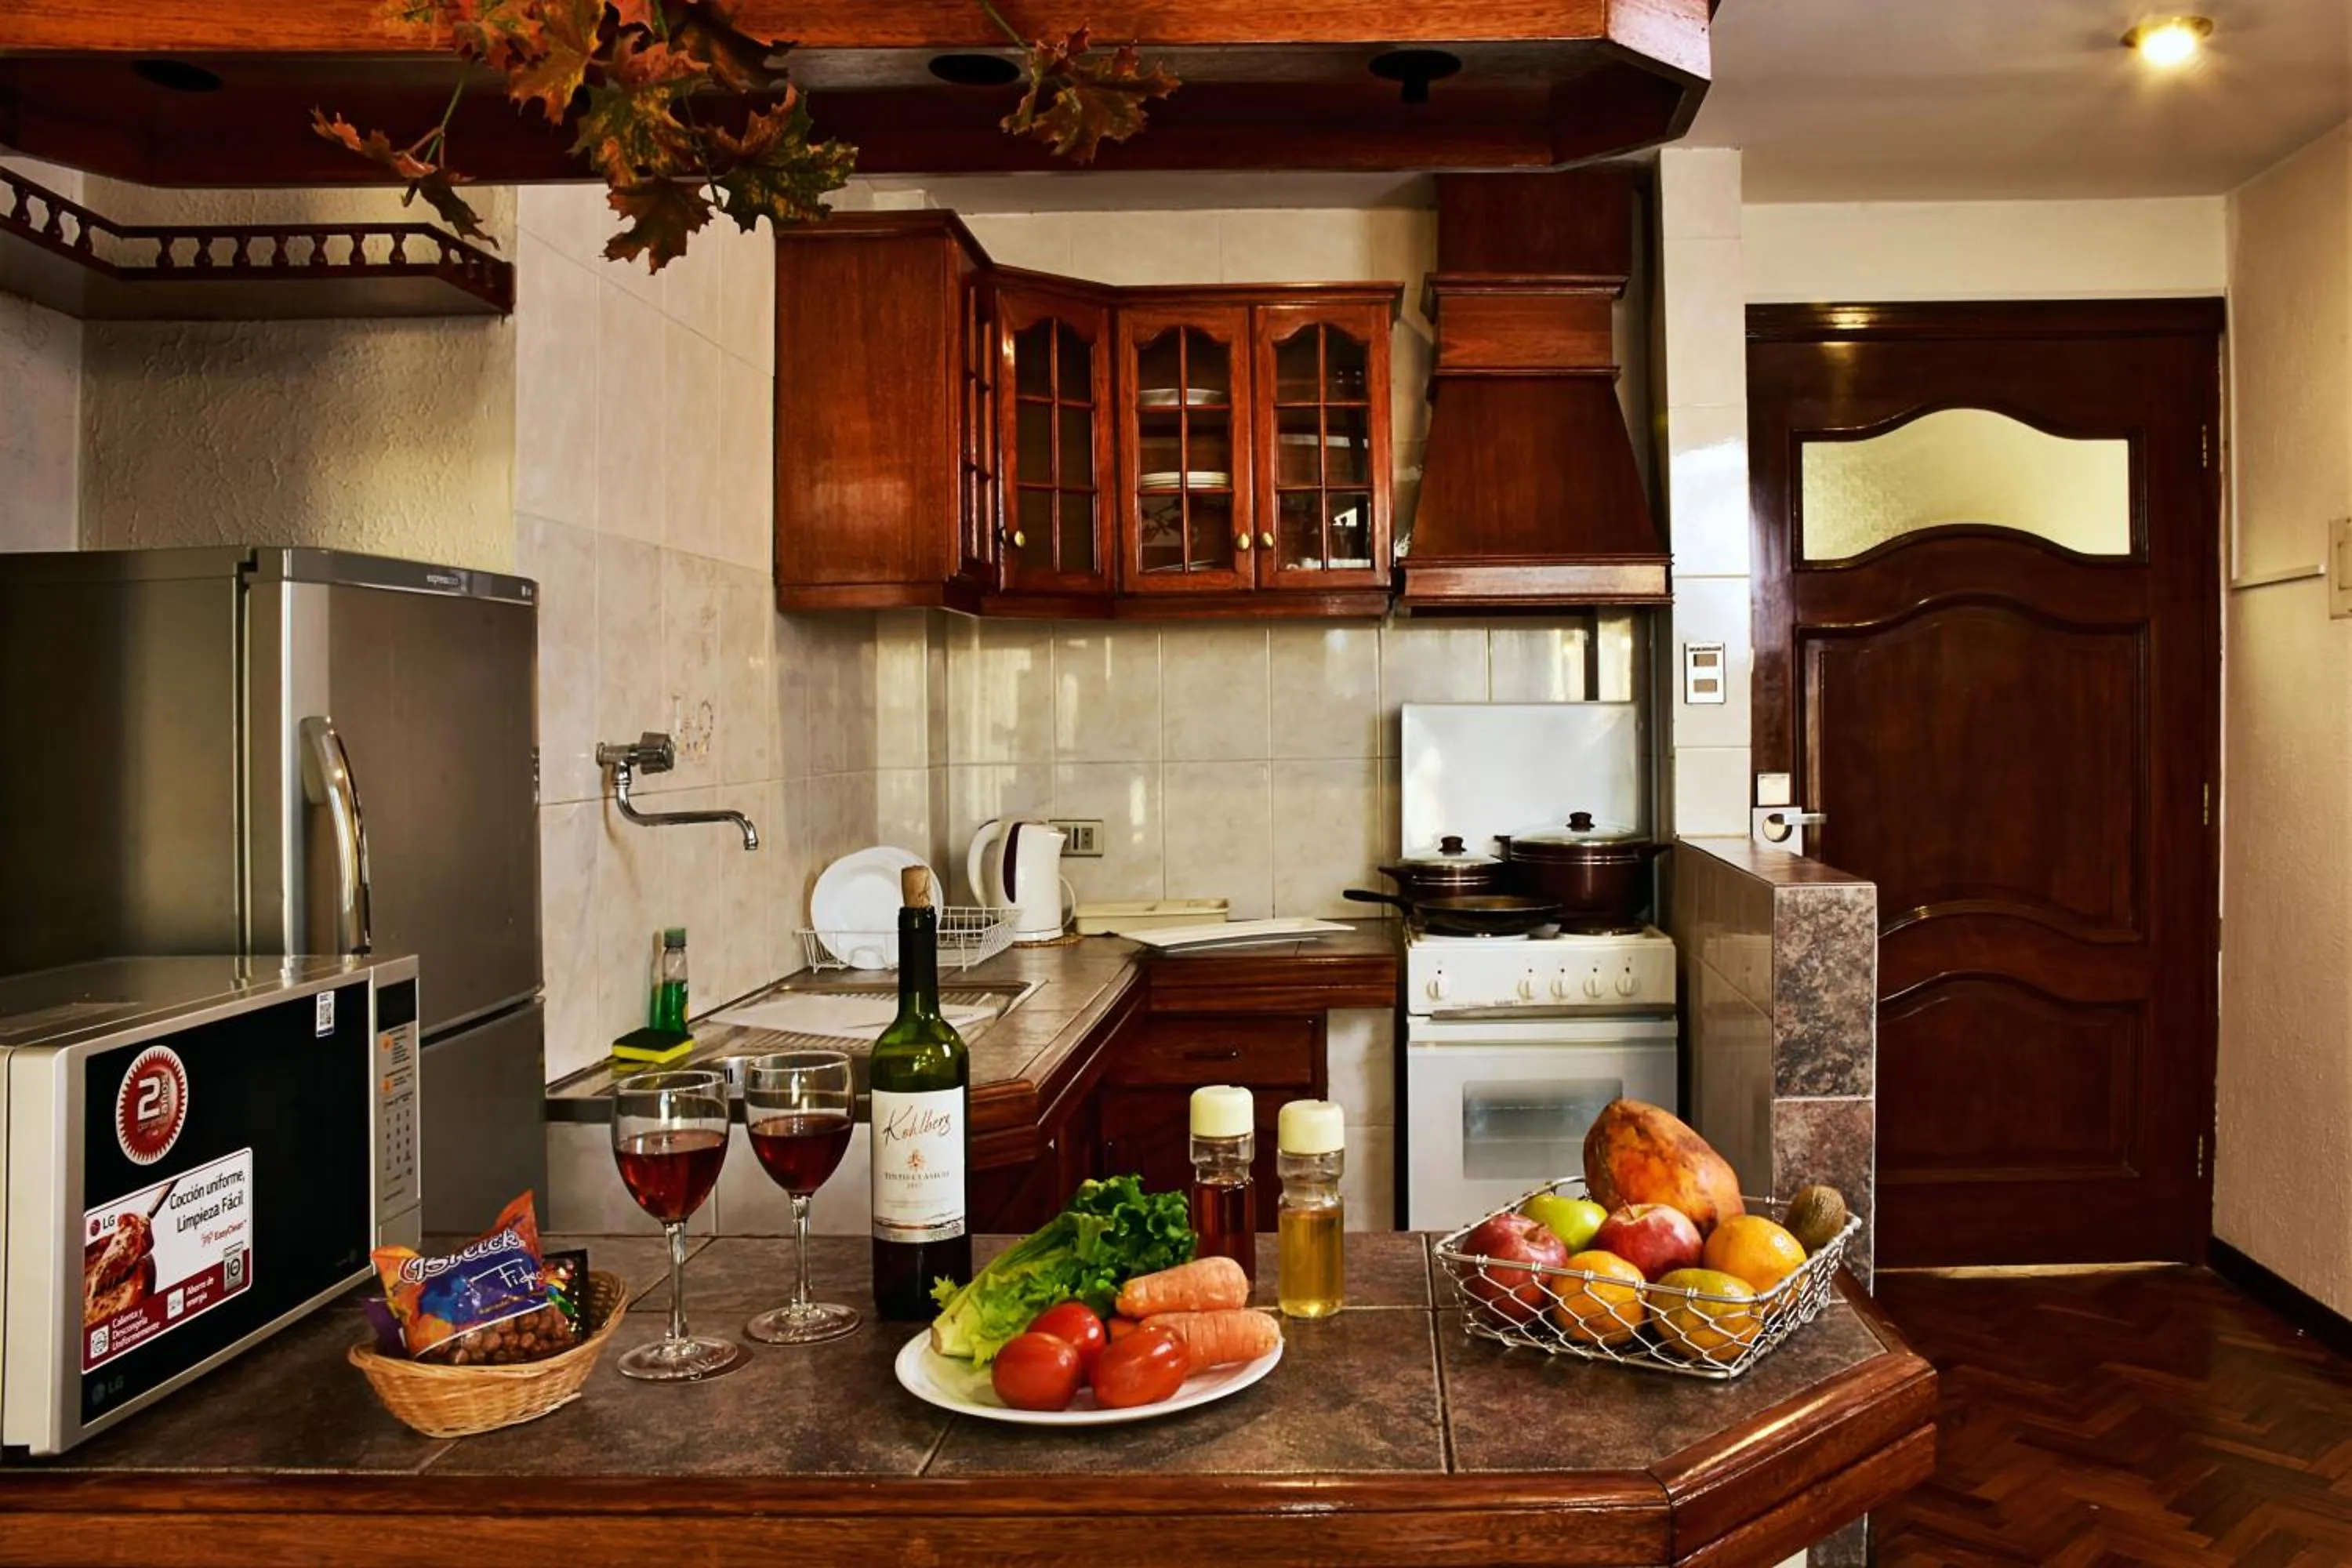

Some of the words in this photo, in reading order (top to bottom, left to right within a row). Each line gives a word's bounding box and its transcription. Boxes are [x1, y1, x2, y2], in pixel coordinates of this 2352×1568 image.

[137, 1076, 161, 1121] 2
[882, 1104, 952, 1145] Kohlberg
[169, 1184, 205, 1210] Cocción
[206, 1171, 245, 1196] uniforme,
[103, 1214, 116, 1230] LG
[176, 1203, 220, 1233] Limpieza
[221, 1190, 244, 1213] Fácil
[226, 1258, 241, 1279] 10
